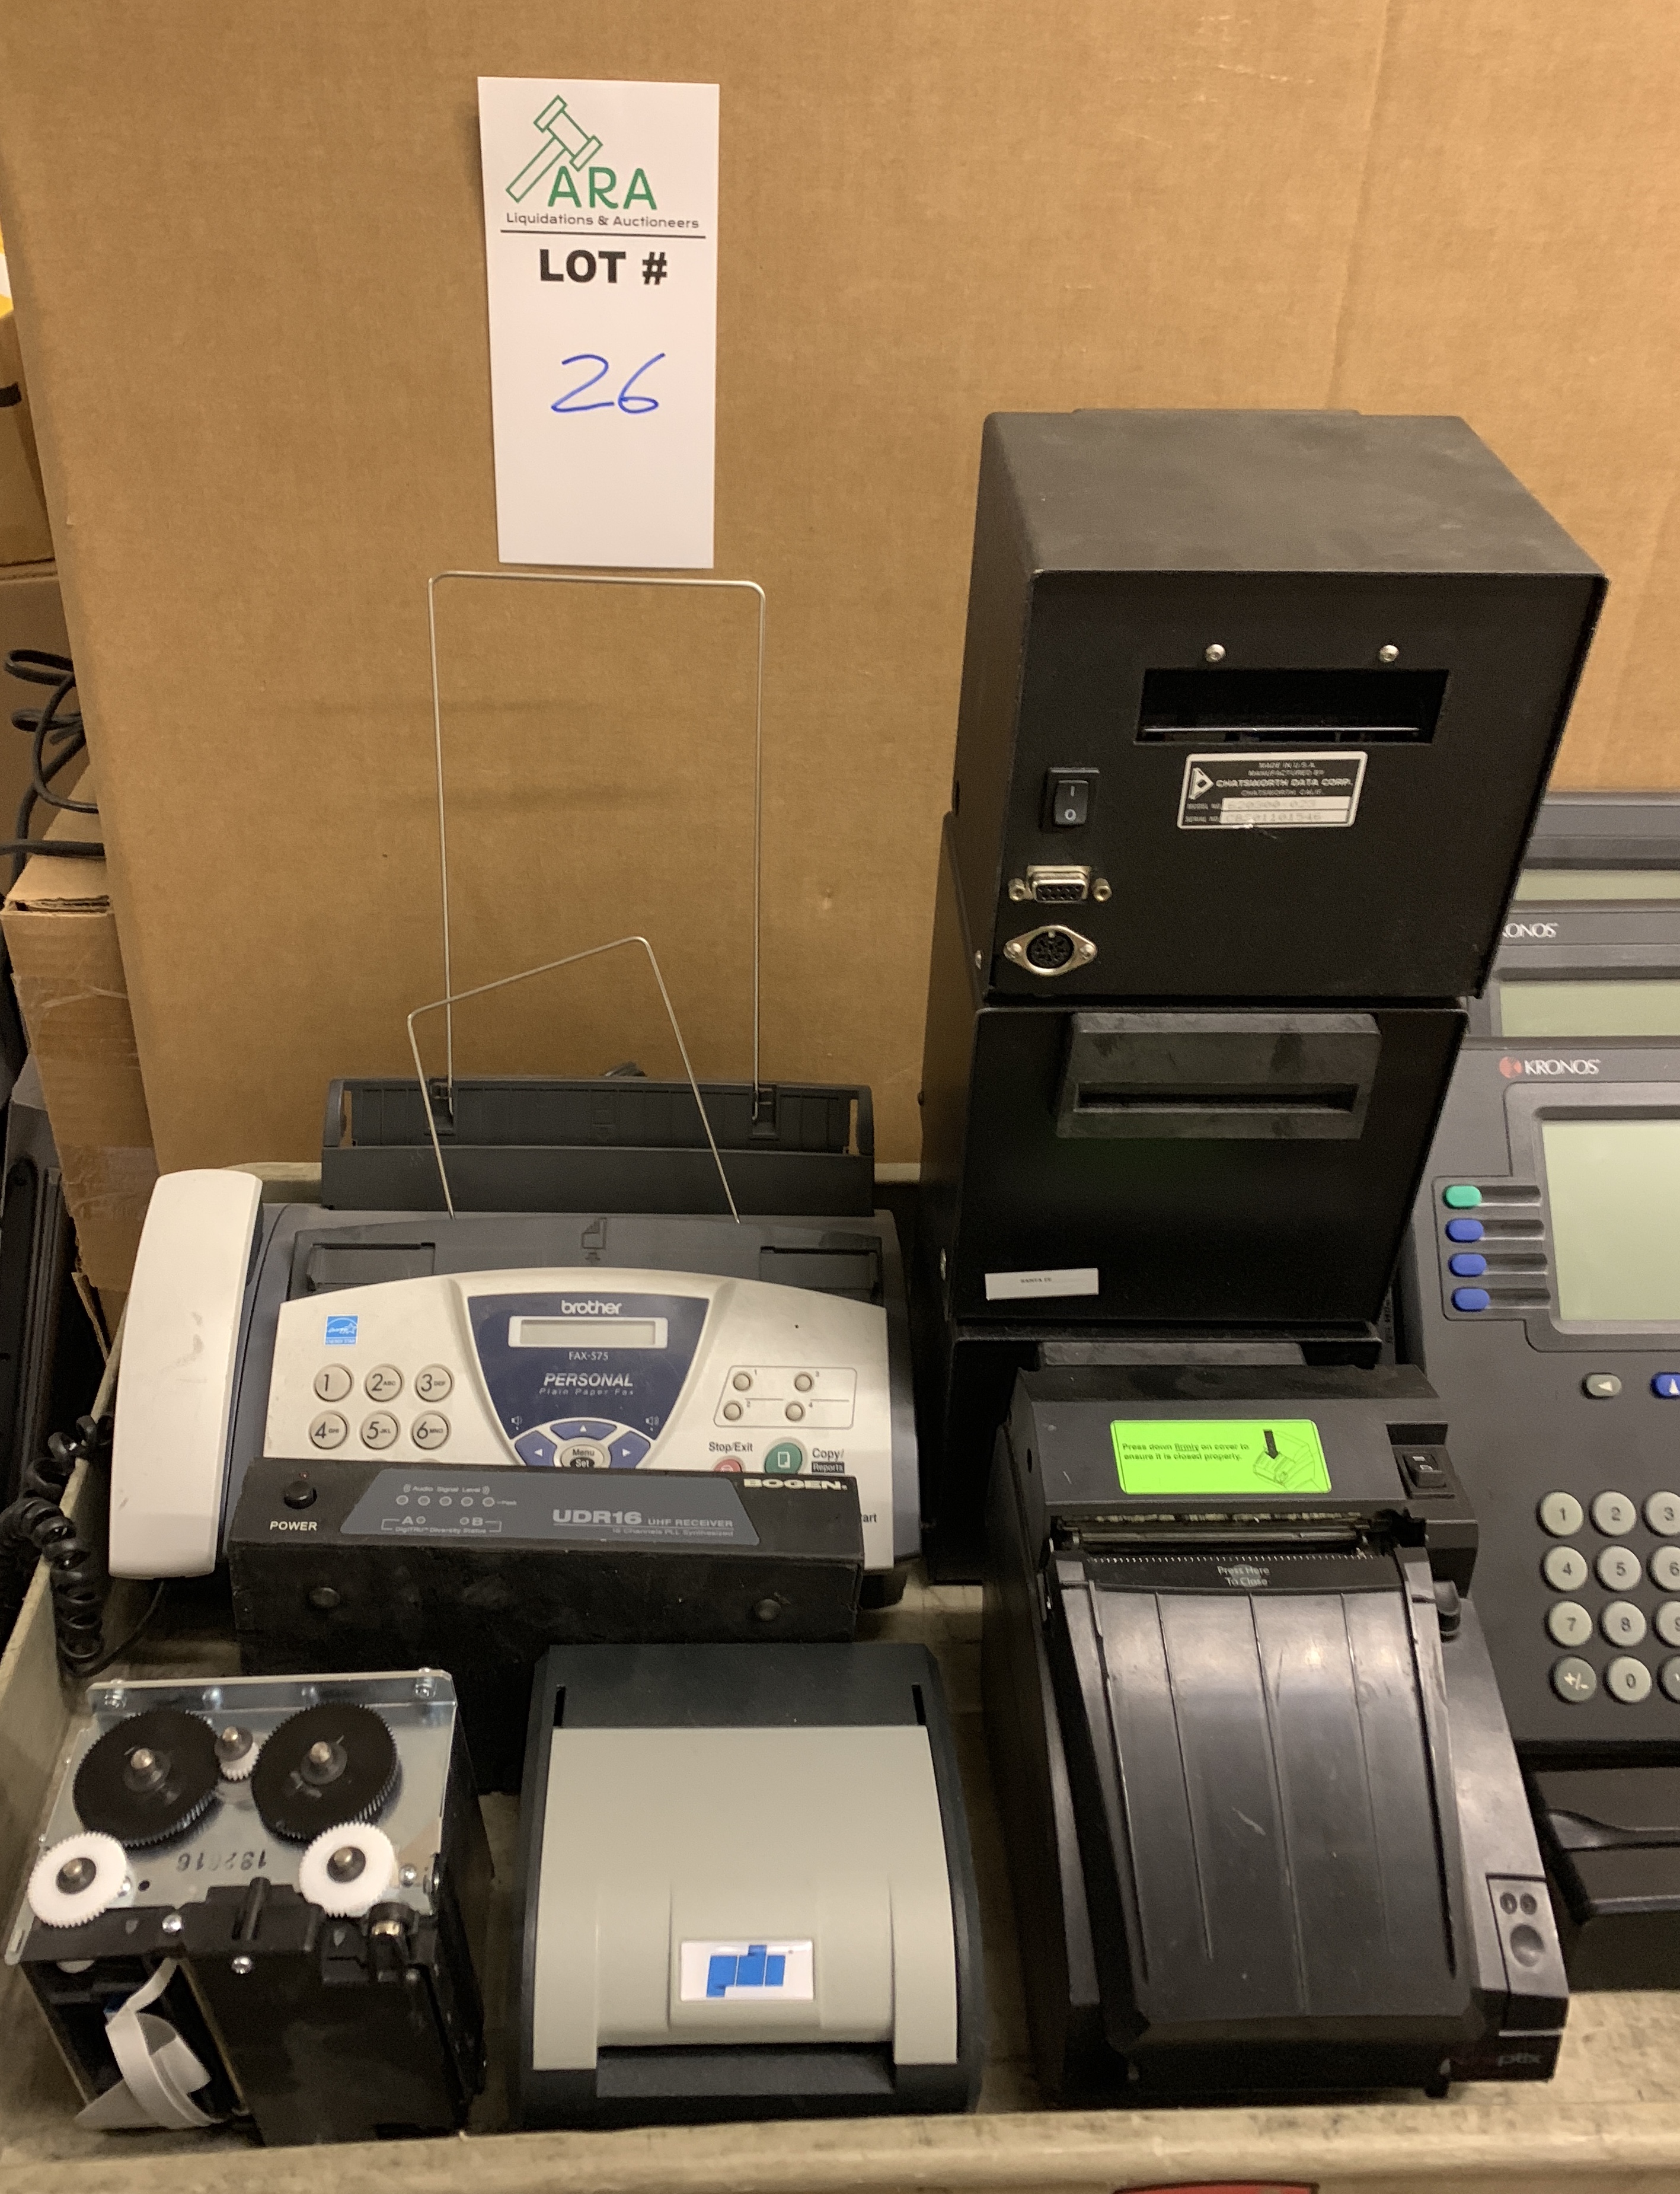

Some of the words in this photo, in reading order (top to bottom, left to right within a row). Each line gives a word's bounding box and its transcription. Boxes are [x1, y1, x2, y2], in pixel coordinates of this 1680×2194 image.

[547, 165, 657, 209] ARA
[506, 212, 593, 226] Liquidations
[598, 215, 609, 225] &
[613, 215, 700, 229] Auctioneers
[539, 248, 627, 283] LOT
[642, 251, 667, 285] #
[550, 352, 666, 414] 26
[1216, 778, 1289, 787] CHATSWORTH
[1291, 779, 1319, 787] DATA
[1502, 923, 1559, 938] ONOS
[1525, 1059, 1601, 1075] KRONOS
[561, 1300, 622, 1315] brother
[324, 1374, 329, 1392] 1
[371, 1373, 383, 1391] 2
[421, 1374, 432, 1392] 3
[544, 1373, 633, 1387] PERSONAL
[314, 1422, 327, 1439] 4
[367, 1421, 379, 1440] 5
[417, 1421, 428, 1440] 6
[709, 1442, 753, 1453] Stop/Exit
[576, 1459, 589, 1468] Set
[402, 1516, 414, 1525] A
[472, 1517, 483, 1526] B
[552, 1509, 642, 1525] UDR16
[675, 1519, 733, 1527] RECEIVER
[1559, 1507, 1566, 1522] 1
[1611, 1507, 1621, 1522] 2
[1664, 1506, 1675, 1522] 3
[270, 1521, 317, 1532] POWER
[1217, 1565, 1244, 1576] Press
[1245, 1566, 1270, 1576] Here
[1563, 1562, 1572, 1576] 4
[1617, 1561, 1626, 1577] 5
[1669, 1561, 1680, 1577] 6
[1225, 1577, 1238, 1587] To
[1240, 1577, 1268, 1587] Close
[1566, 1617, 1576, 1632] 7
[1620, 1616, 1631, 1632] 8
